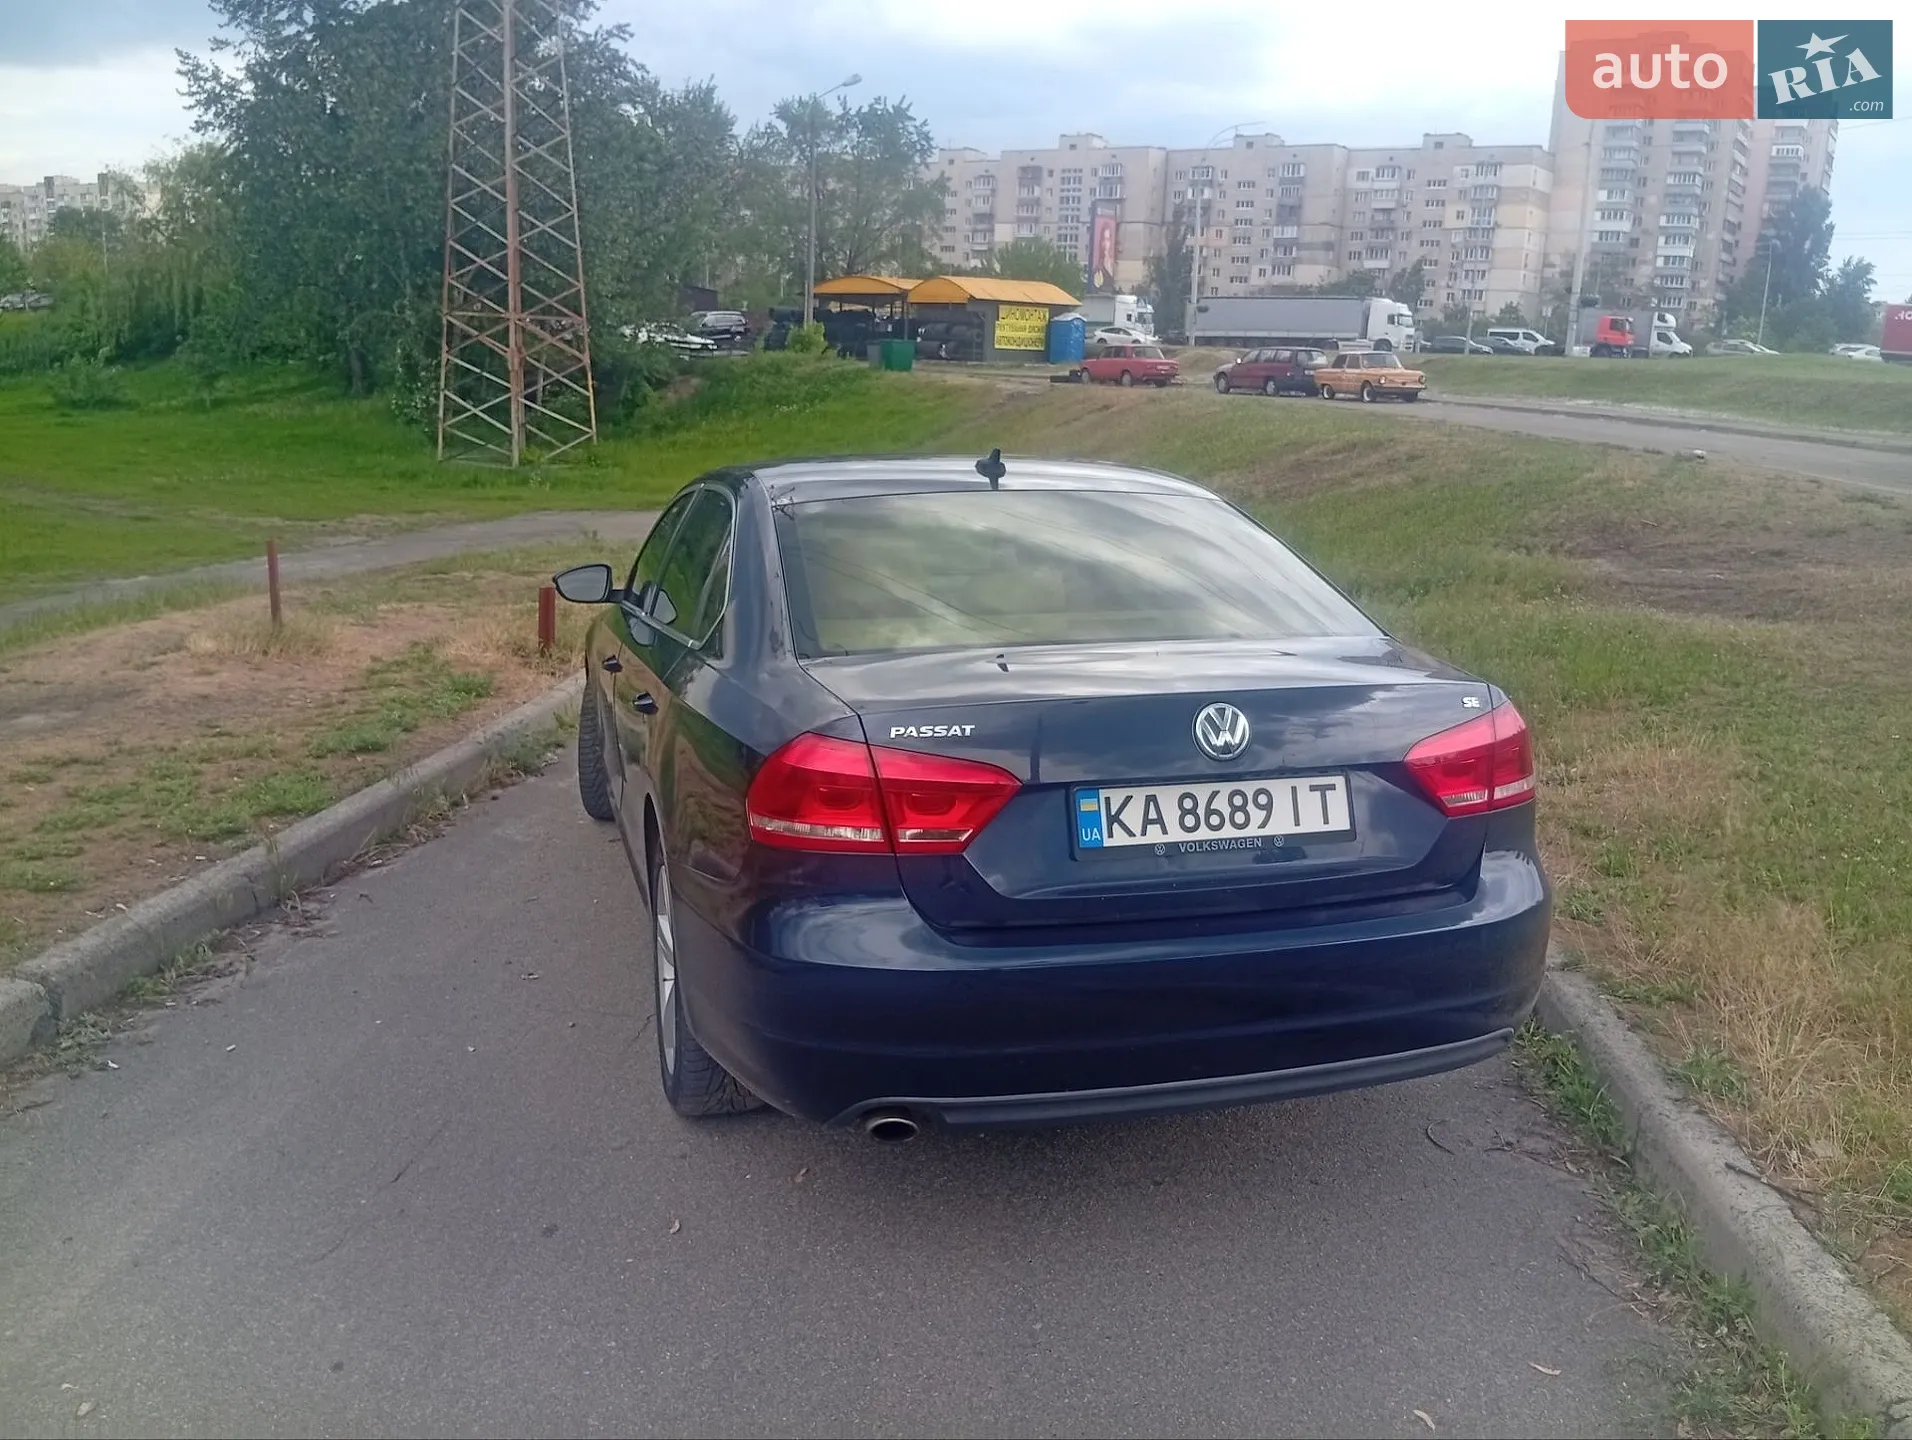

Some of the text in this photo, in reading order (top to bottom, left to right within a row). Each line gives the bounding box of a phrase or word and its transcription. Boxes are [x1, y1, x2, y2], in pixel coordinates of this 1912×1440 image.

[1462, 696, 1480, 708] SE
[889, 724, 976, 739] PASSAT
[1103, 783, 1337, 839] KA 8689 IT
[1081, 827, 1101, 842] UA
[1178, 837, 1262, 854] VOLKSWAGEN
